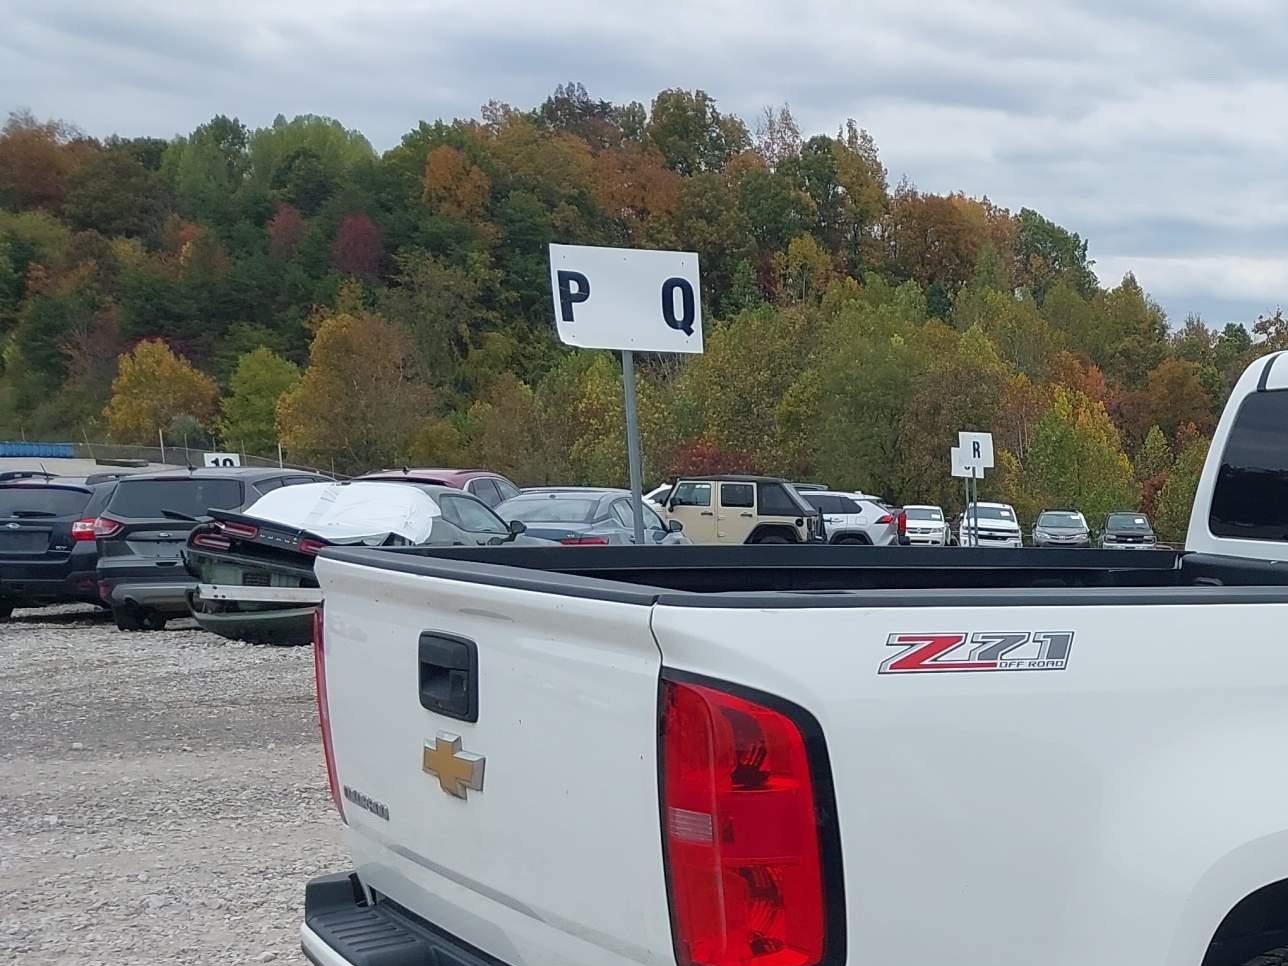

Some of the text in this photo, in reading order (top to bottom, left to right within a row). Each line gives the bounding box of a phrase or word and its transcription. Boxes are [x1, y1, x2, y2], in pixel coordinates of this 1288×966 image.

[557, 269, 696, 337] P Q
[972, 440, 981, 458] R
[878, 632, 1075, 674] Z71
[999, 660, 1065, 669] OFF ROAD
